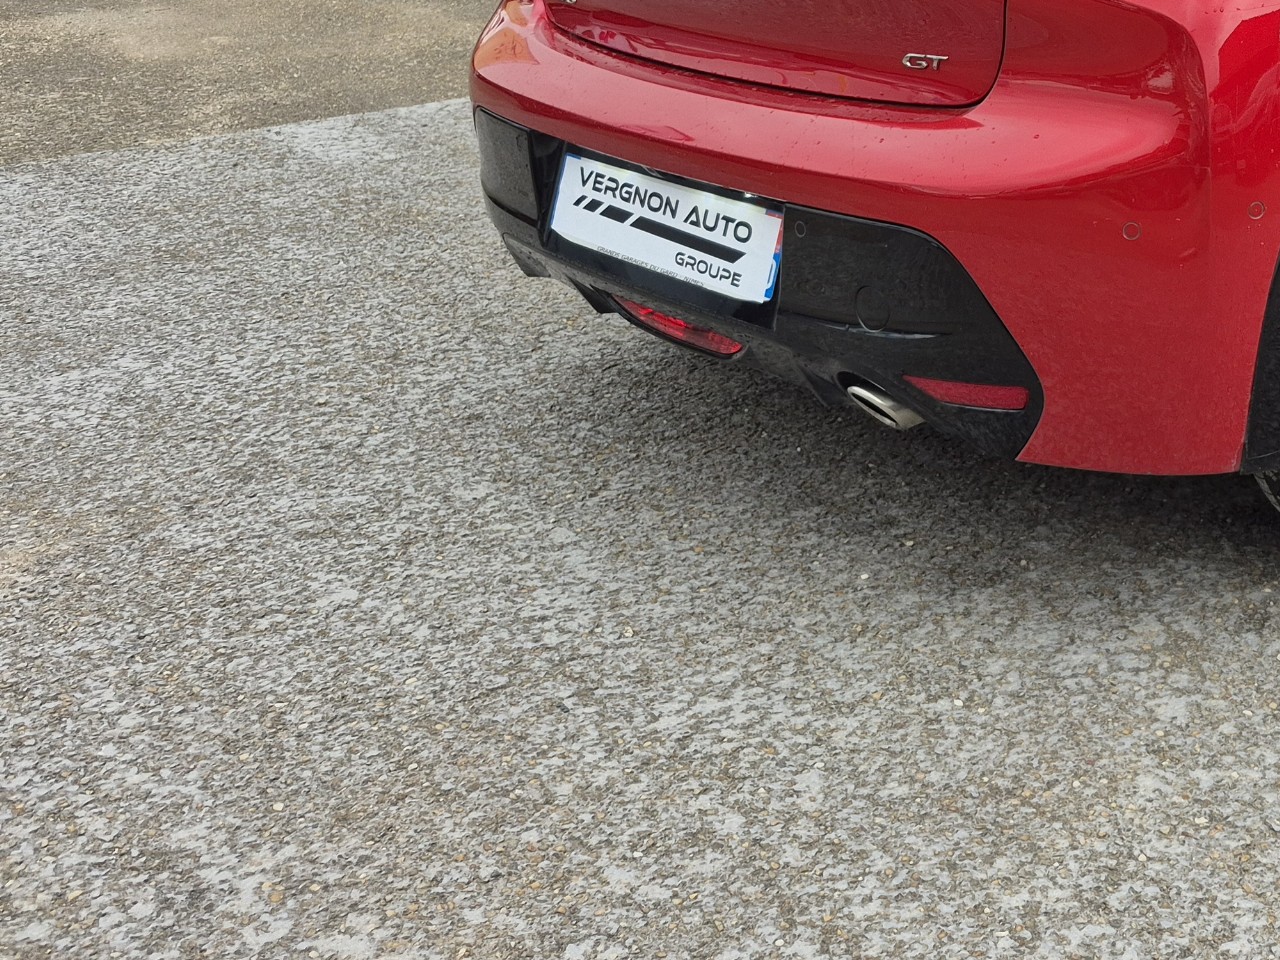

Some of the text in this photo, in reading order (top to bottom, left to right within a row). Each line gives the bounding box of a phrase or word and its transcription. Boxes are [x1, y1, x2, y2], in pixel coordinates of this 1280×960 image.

[902, 53, 949, 71] GT
[579, 166, 753, 244] VERGNON AUTO
[675, 251, 743, 288] GROUPE
